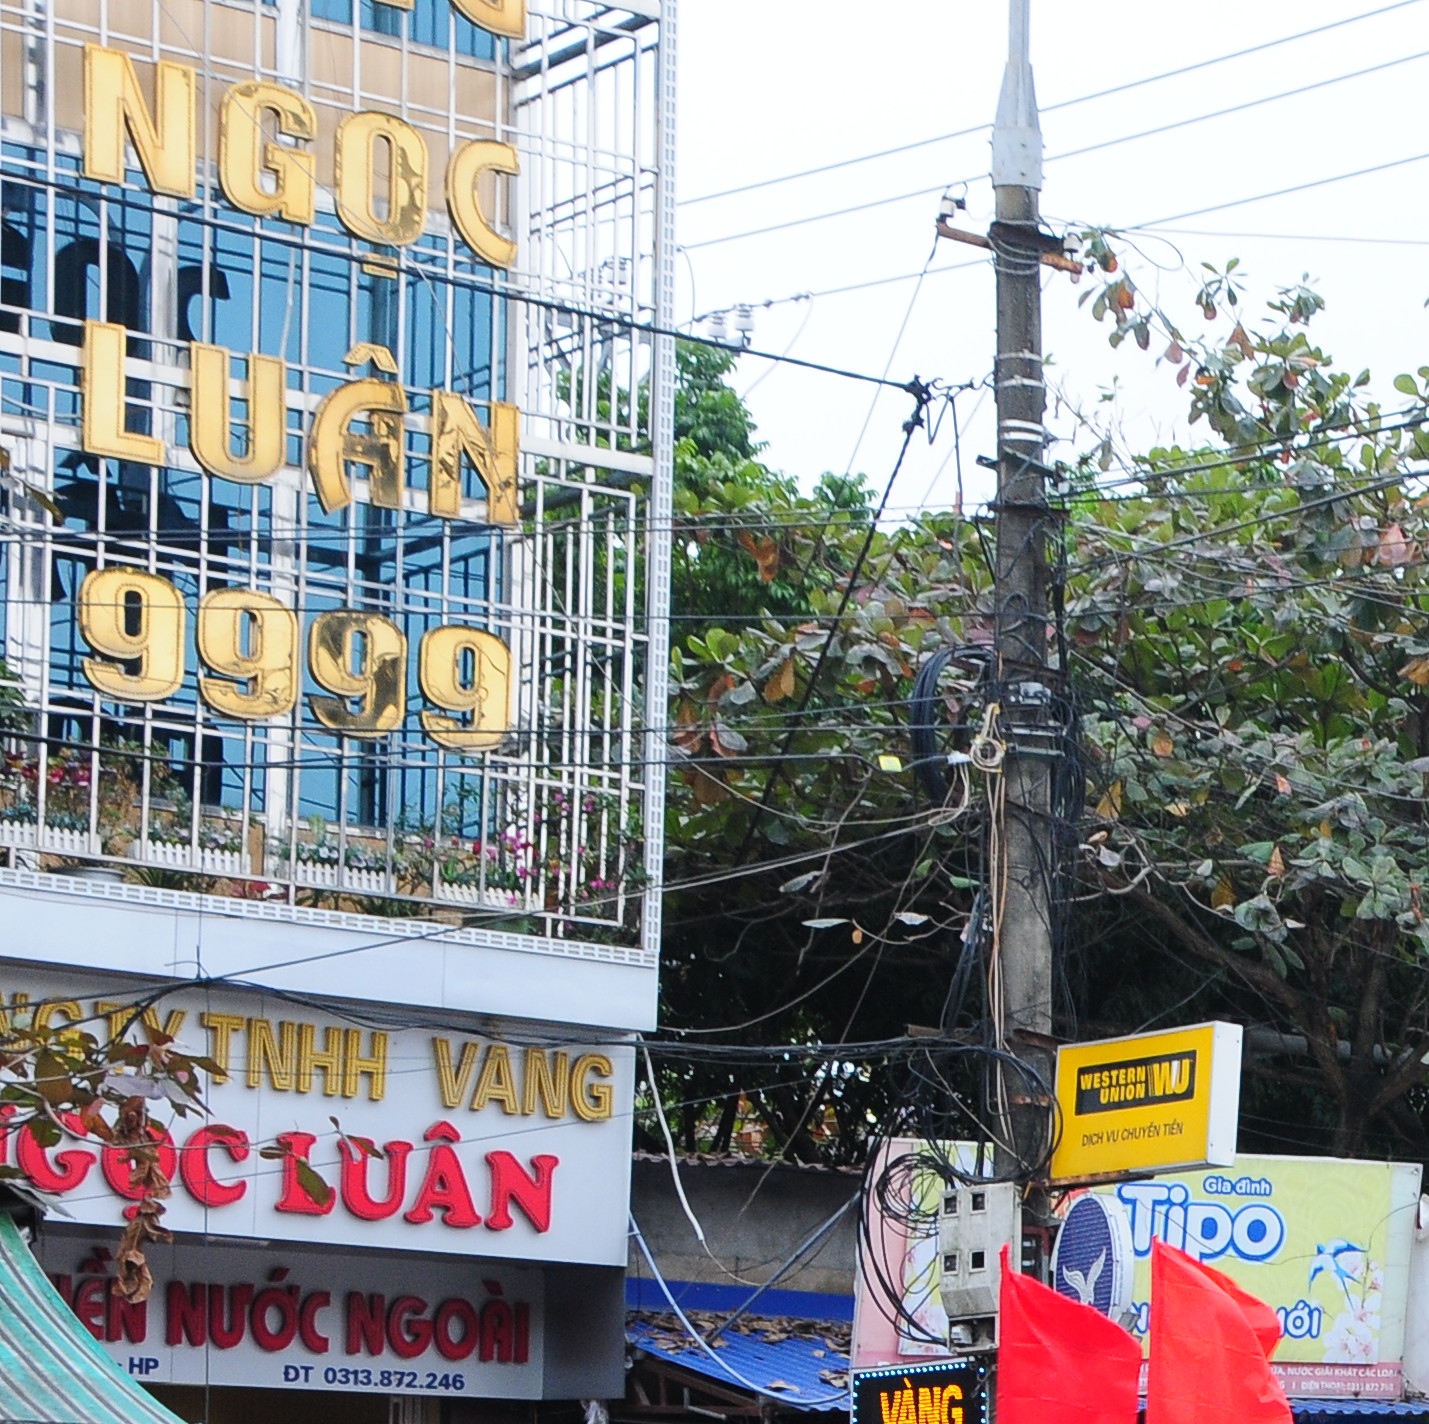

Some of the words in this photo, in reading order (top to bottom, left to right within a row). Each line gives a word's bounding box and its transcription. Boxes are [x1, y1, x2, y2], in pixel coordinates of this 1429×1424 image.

[83, 42, 520, 280] NGỌC
[82, 320, 520, 525] LUÂN
[78, 566, 512, 751] 9999
[201, 1012, 388, 1100] TNHH
[432, 1037, 615, 1122] VANG
[1080, 1066, 1146, 1090] WESTERN
[1100, 1083, 1145, 1105] UNION
[276, 1121, 560, 1234] LUÂN
[1117, 1183, 1286, 1262] Tipo
[1203, 1176, 1233, 1195] Gia
[1233, 1176, 1273, 1196] đình
[165, 1265, 331, 1354] NƯỚC
[345, 1278, 531, 1364] NGOÀI
[127, 1356, 160, 1375] HP
[283, 1364, 315, 1384] ĐT
[323, 1367, 466, 1393] 0313.872.246
